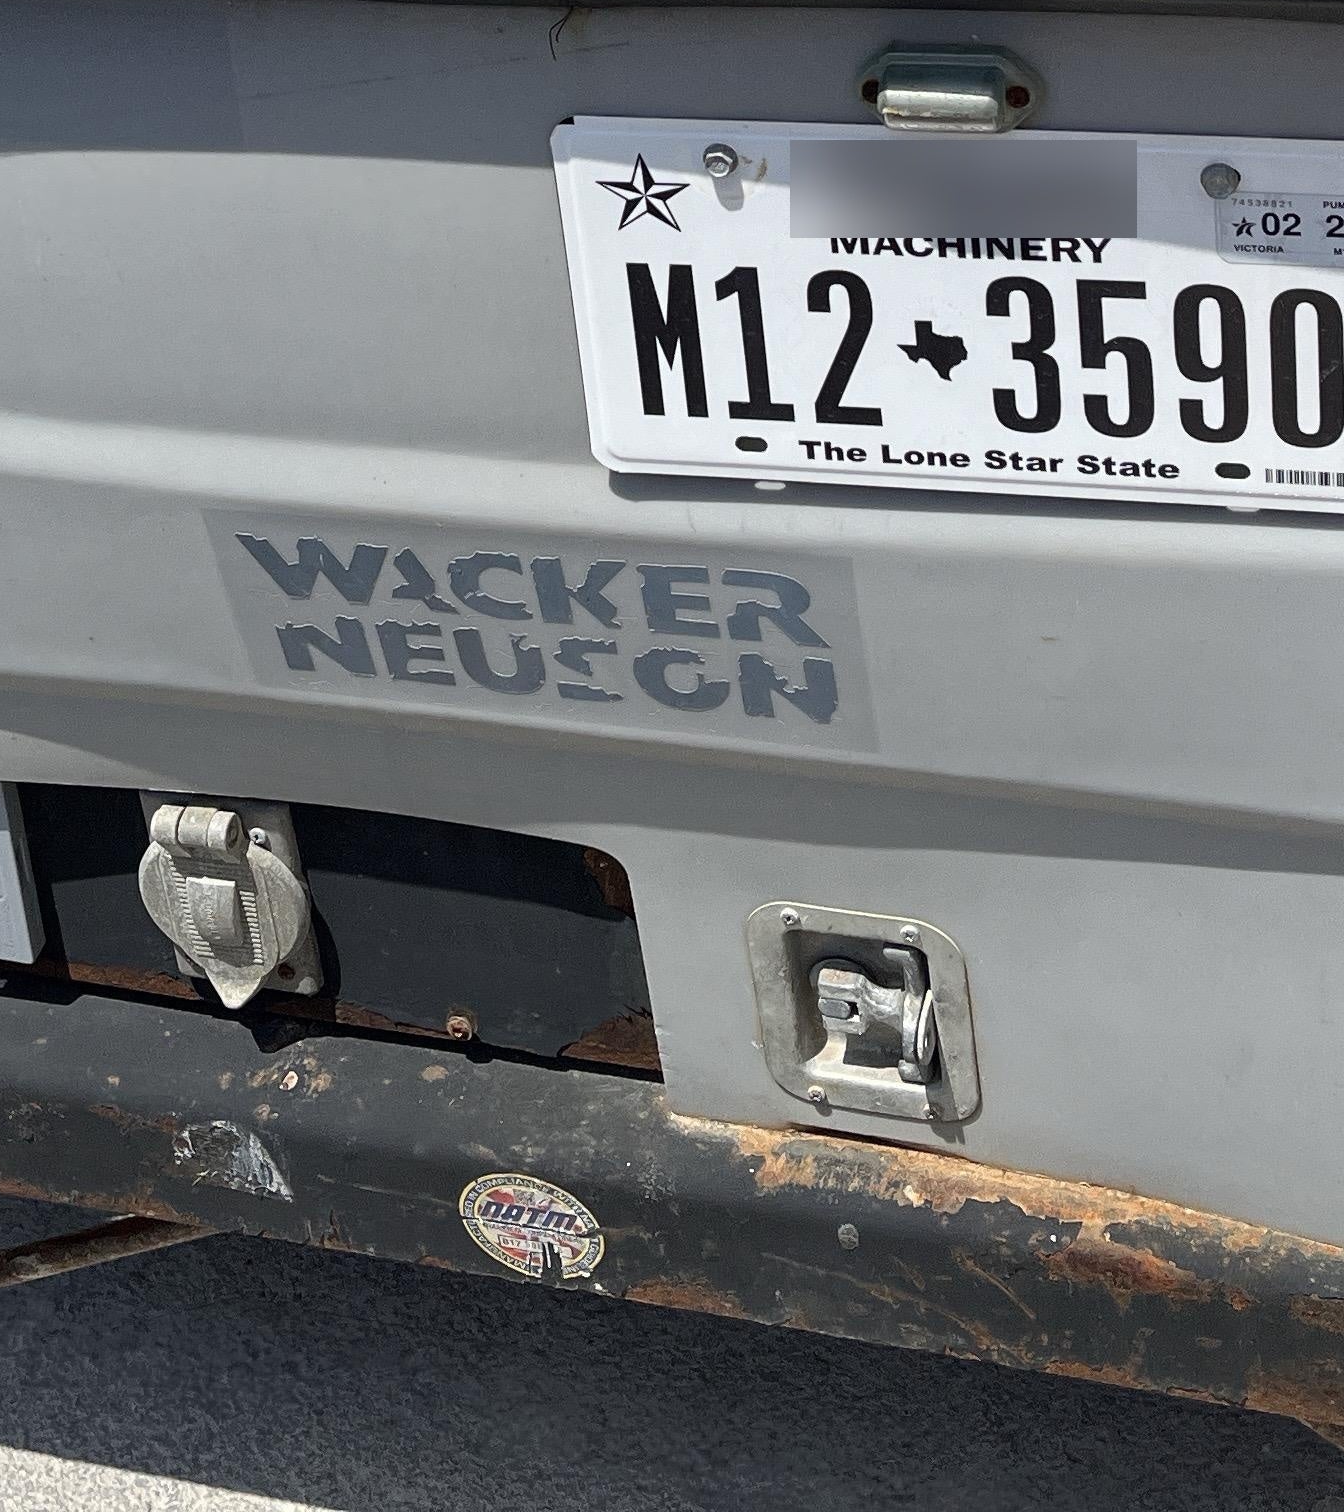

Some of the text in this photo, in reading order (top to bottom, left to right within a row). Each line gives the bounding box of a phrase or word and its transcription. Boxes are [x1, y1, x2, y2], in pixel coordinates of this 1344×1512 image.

[1261, 212, 1302, 237] 02
[829, 237, 1113, 265] MACHINERY
[1233, 244, 1285, 254] VICTORIA
[624, 261, 883, 427] M12
[798, 439, 1181, 480] The Lone Star State
[233, 531, 832, 649] WACKER
